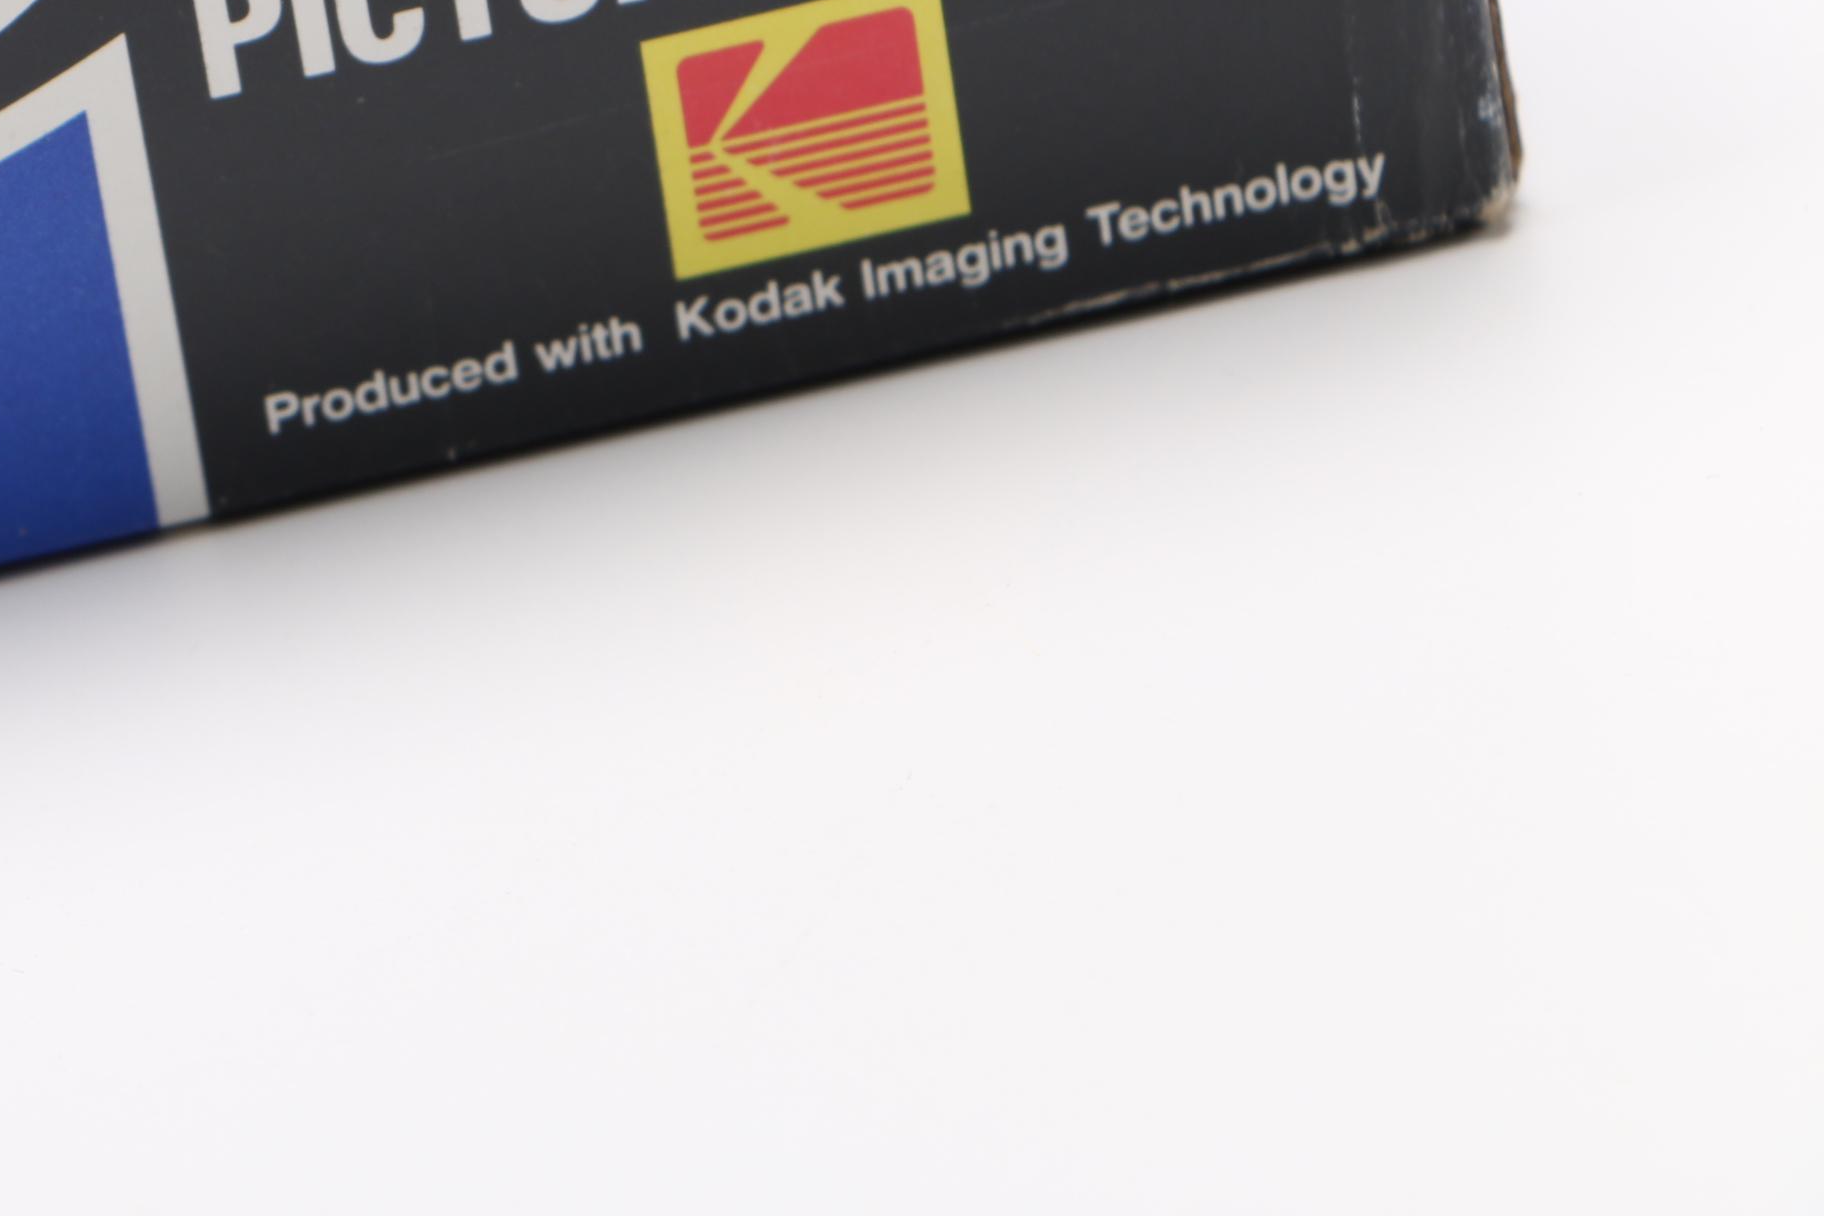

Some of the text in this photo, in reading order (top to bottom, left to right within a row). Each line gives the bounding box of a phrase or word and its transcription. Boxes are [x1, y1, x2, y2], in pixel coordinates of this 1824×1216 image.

[265, 154, 1386, 433] Produced with Kodak Imaging Technology
